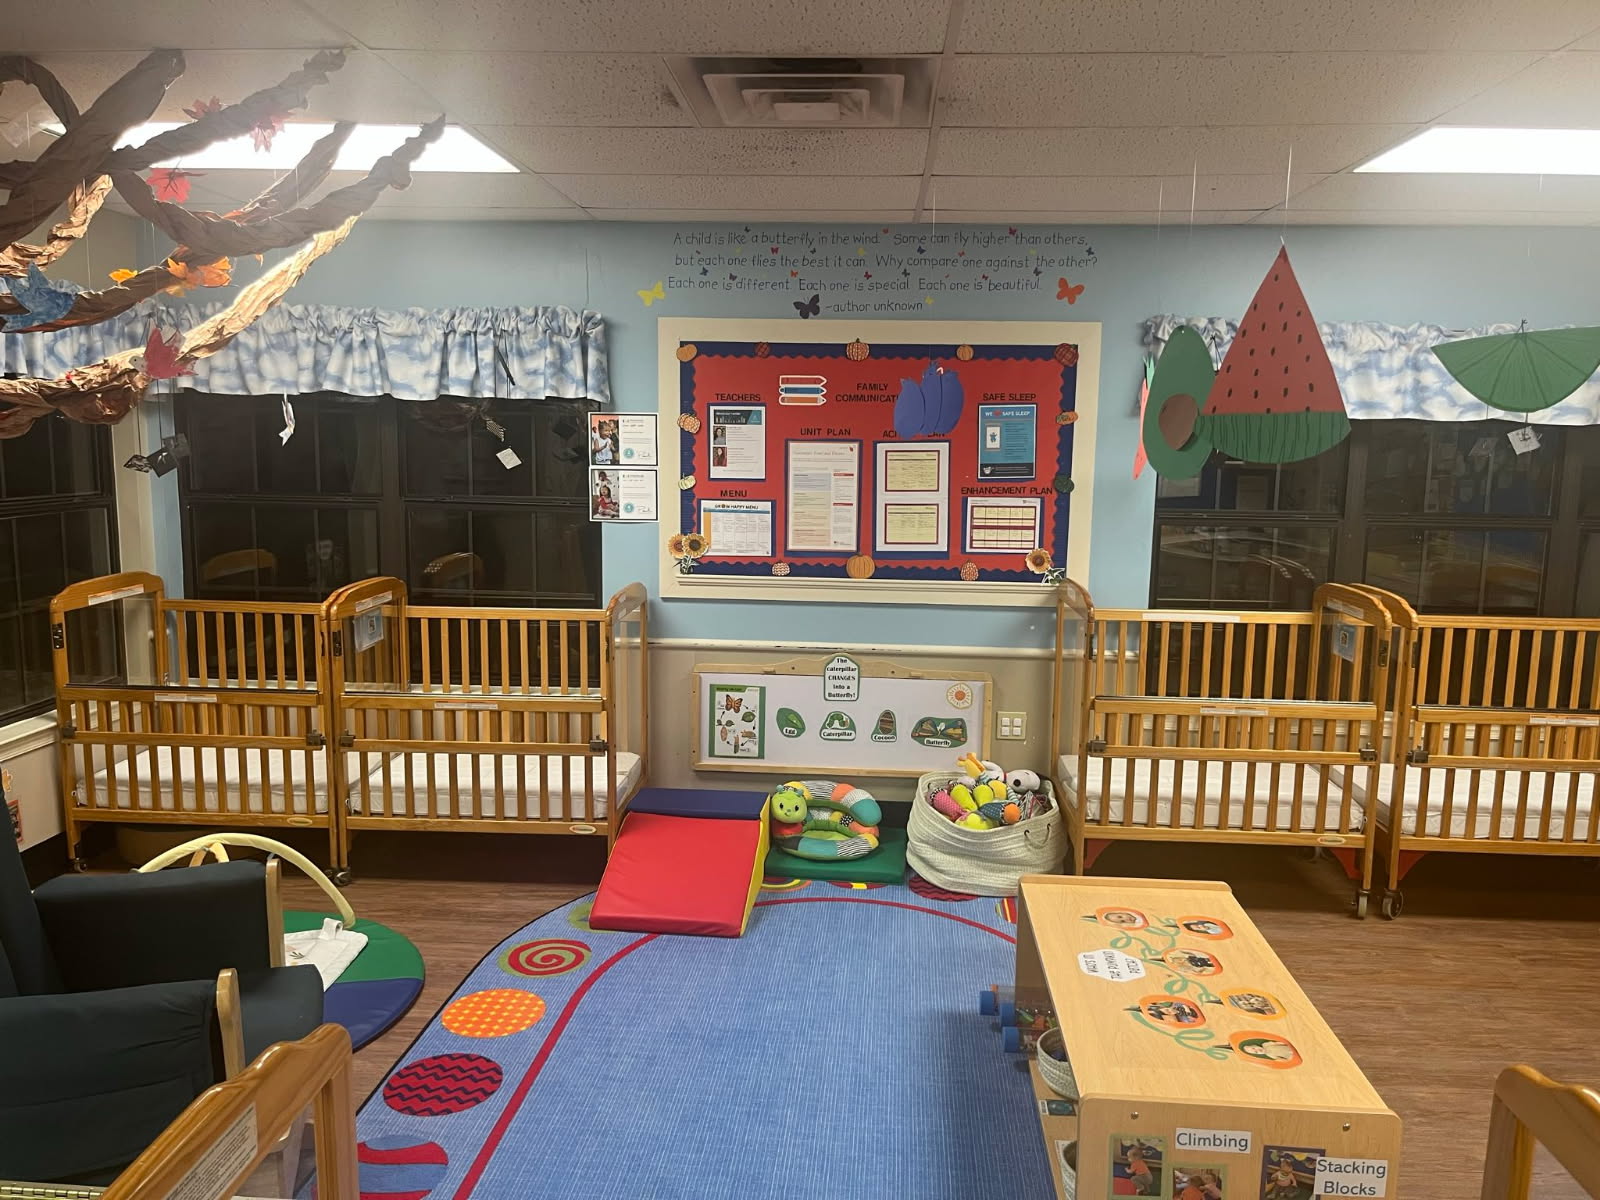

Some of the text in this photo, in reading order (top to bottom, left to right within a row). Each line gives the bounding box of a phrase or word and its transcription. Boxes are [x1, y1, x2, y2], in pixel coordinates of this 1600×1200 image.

[673, 232, 682, 245] A
[685, 231, 711, 245] child
[715, 232, 725, 245] is
[727, 232, 746, 245] like
[751, 235, 759, 243] a
[761, 231, 814, 248] butterfly
[818, 232, 828, 245] in
[831, 231, 850, 245] the
[894, 233, 927, 246] Some
[930, 234, 950, 244] can
[954, 232, 969, 247] fly
[972, 232, 1009, 248] higher
[1015, 233, 1041, 245] than
[675, 255, 694, 266] but
[698, 254, 726, 266] each
[727, 256, 748, 266] one
[752, 254, 777, 267] flies
[780, 255, 799, 267] the
[802, 255, 829, 268] best
[833, 254, 842, 267] it
[876, 255, 903, 270] Why
[906, 256, 959, 269] compare
[962, 256, 983, 268] one
[985, 255, 1030, 272] against
[1036, 255, 1055, 268] the
[1058, 255, 1098, 268] other?
[668, 276, 695, 289] Each
[698, 279, 718, 290] one
[722, 277, 732, 291] is
[799, 278, 826, 292] Each
[829, 281, 850, 292] one
[854, 278, 864, 291] is
[918, 278, 946, 292] Each
[949, 281, 970, 292] one
[973, 279, 983, 291] is
[873, 300, 923, 312] unknown
[856, 382, 889, 392] FAMILY
[715, 392, 761, 402] TEACHERS
[982, 392, 1037, 402] SAFE SLEEP
[800, 427, 851, 437] UNIT PLAN
[720, 489, 748, 498] MENU
[961, 486, 1053, 495] ENHANCEMENT PLAN
[828, 674, 856, 682] CHANGES
[785, 728, 796, 736] Egg
[822, 730, 853, 738] Caterpillar
[925, 739, 951, 747] Butterfly
[1176, 1131, 1249, 1151] Climbing
[1316, 1159, 1386, 1179] Stacking
[1323, 1180, 1376, 1196] Blocks
